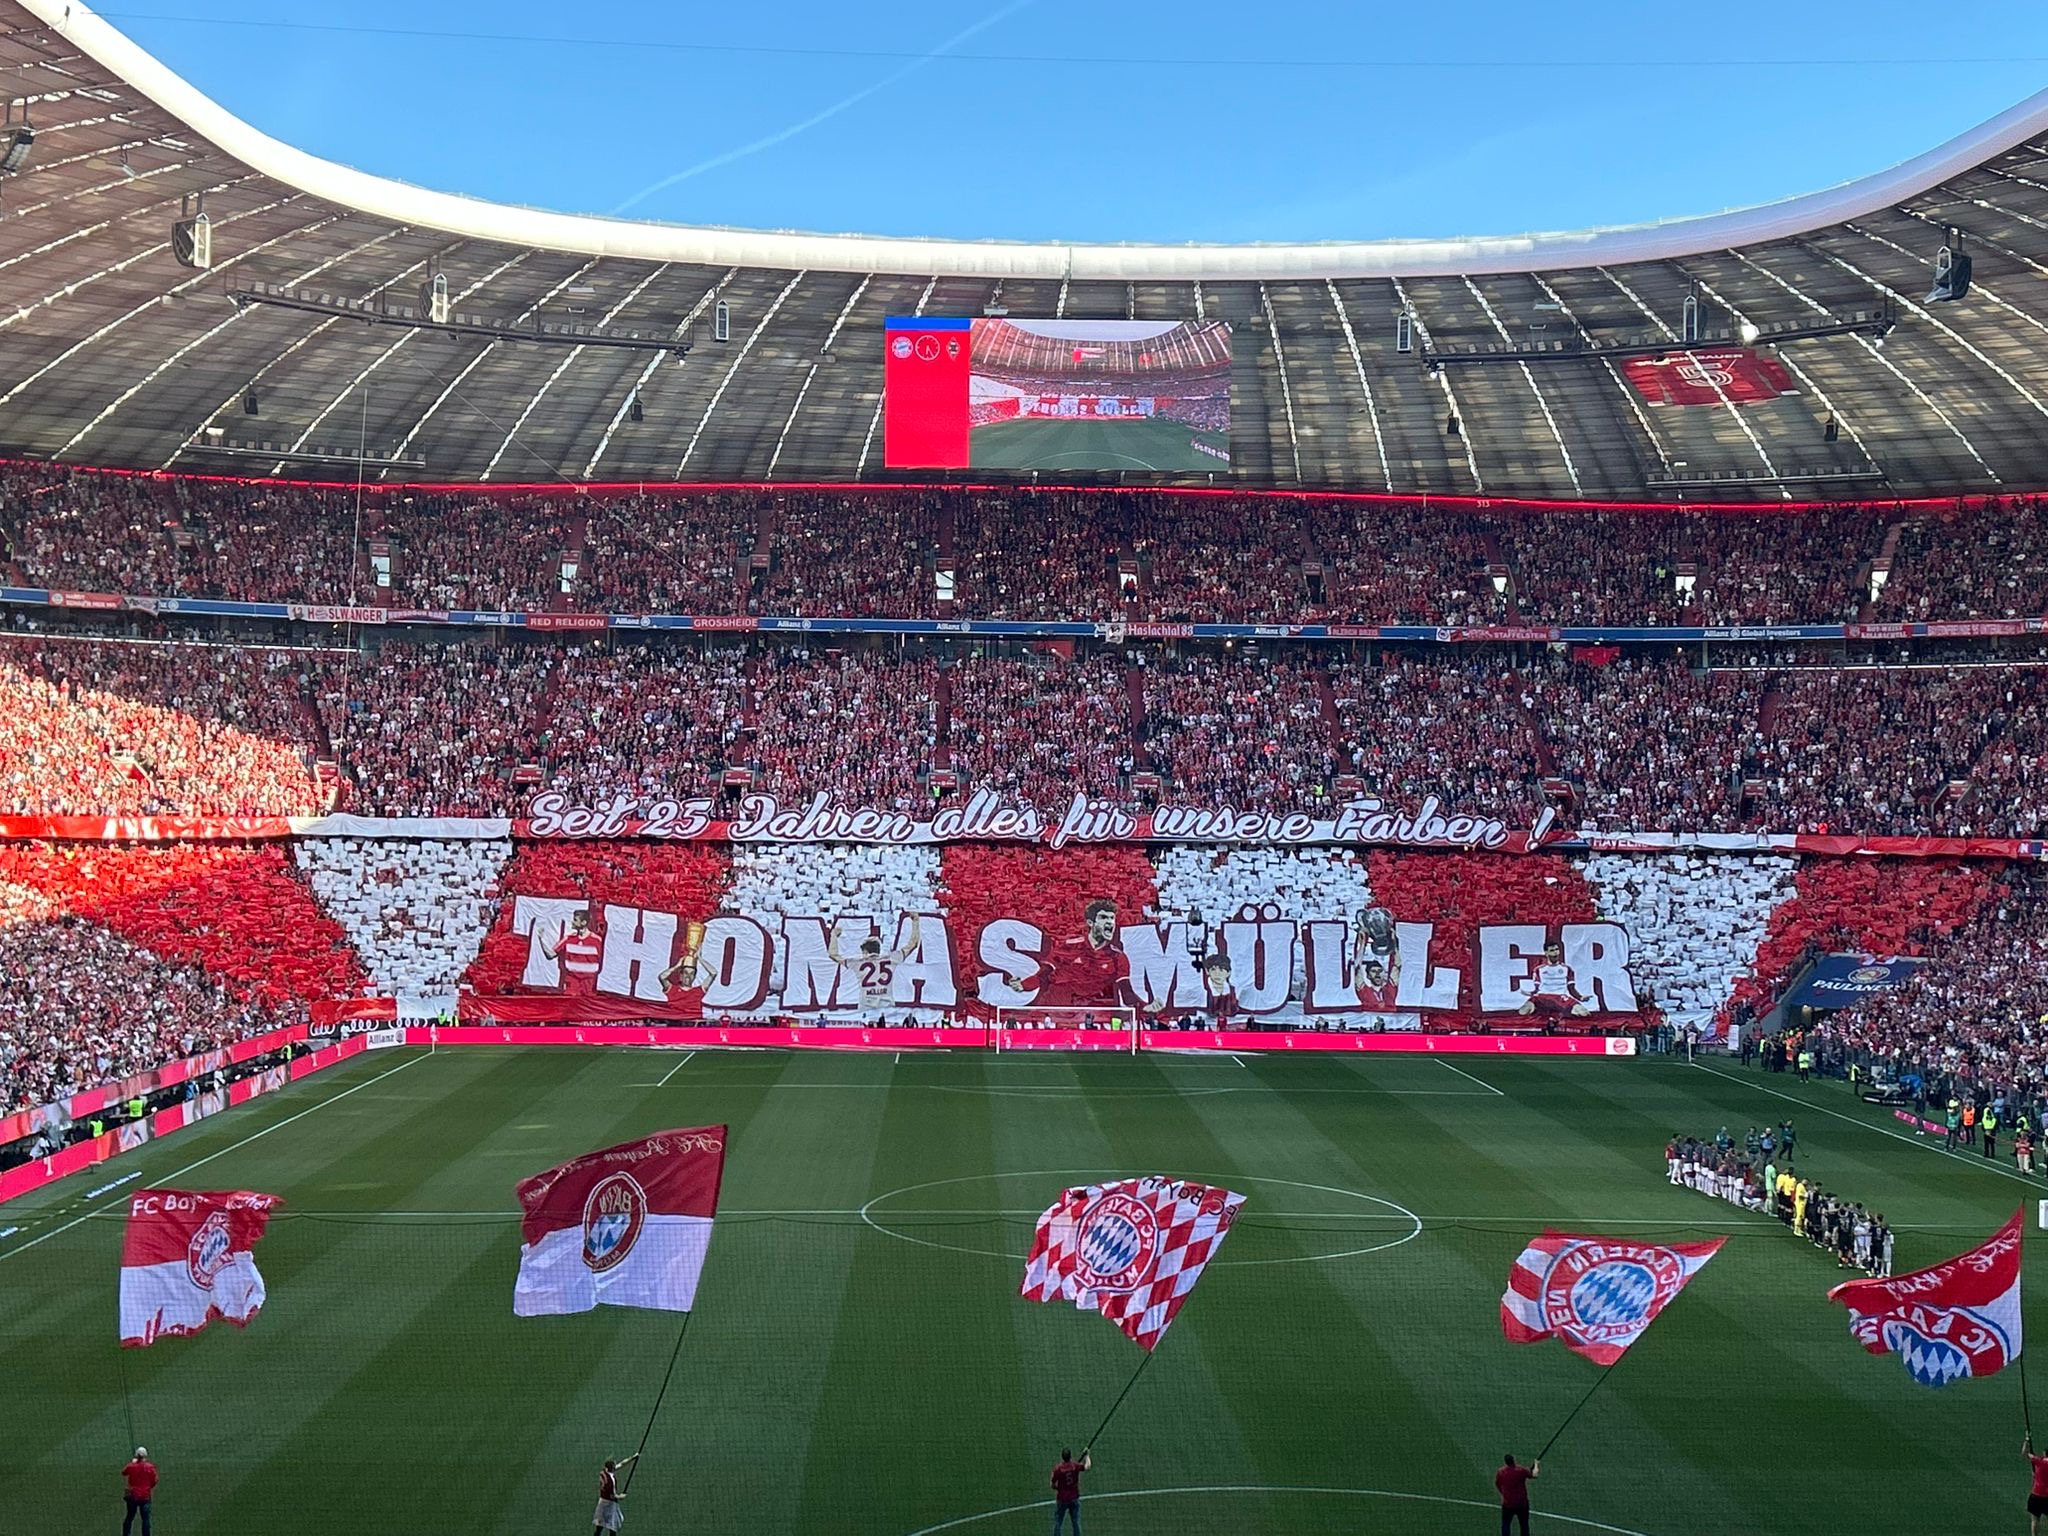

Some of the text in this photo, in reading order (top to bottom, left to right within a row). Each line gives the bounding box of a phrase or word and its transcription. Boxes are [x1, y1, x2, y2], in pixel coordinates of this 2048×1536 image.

[473, 614, 499, 623] Allianz
[529, 618, 605, 628] RED RELIGION
[614, 617, 640, 625] Allianz
[693, 618, 758, 629] GROSSHEIDE
[777, 620, 801, 629] Allianz
[936, 622, 960, 631] Allianz
[1181, 624, 1194, 636] 83
[1254, 626, 1279, 635] Allianz
[1703, 629, 1729, 638] Allianz
[532, 793, 636, 838] Seit
[643, 799, 712, 837] 25
[731, 791, 912, 841] Jahren
[934, 788, 1042, 838] alles
[1056, 792, 1135, 848] für
[1152, 802, 1311, 840] unsere
[1334, 796, 1506, 844] Farben
[513, 896, 1638, 1013] THOMAS MÜLLER
[859, 960, 893, 988] 25
[368, 1030, 396, 1044] Allianz
[132, 1196, 159, 1217] FC
